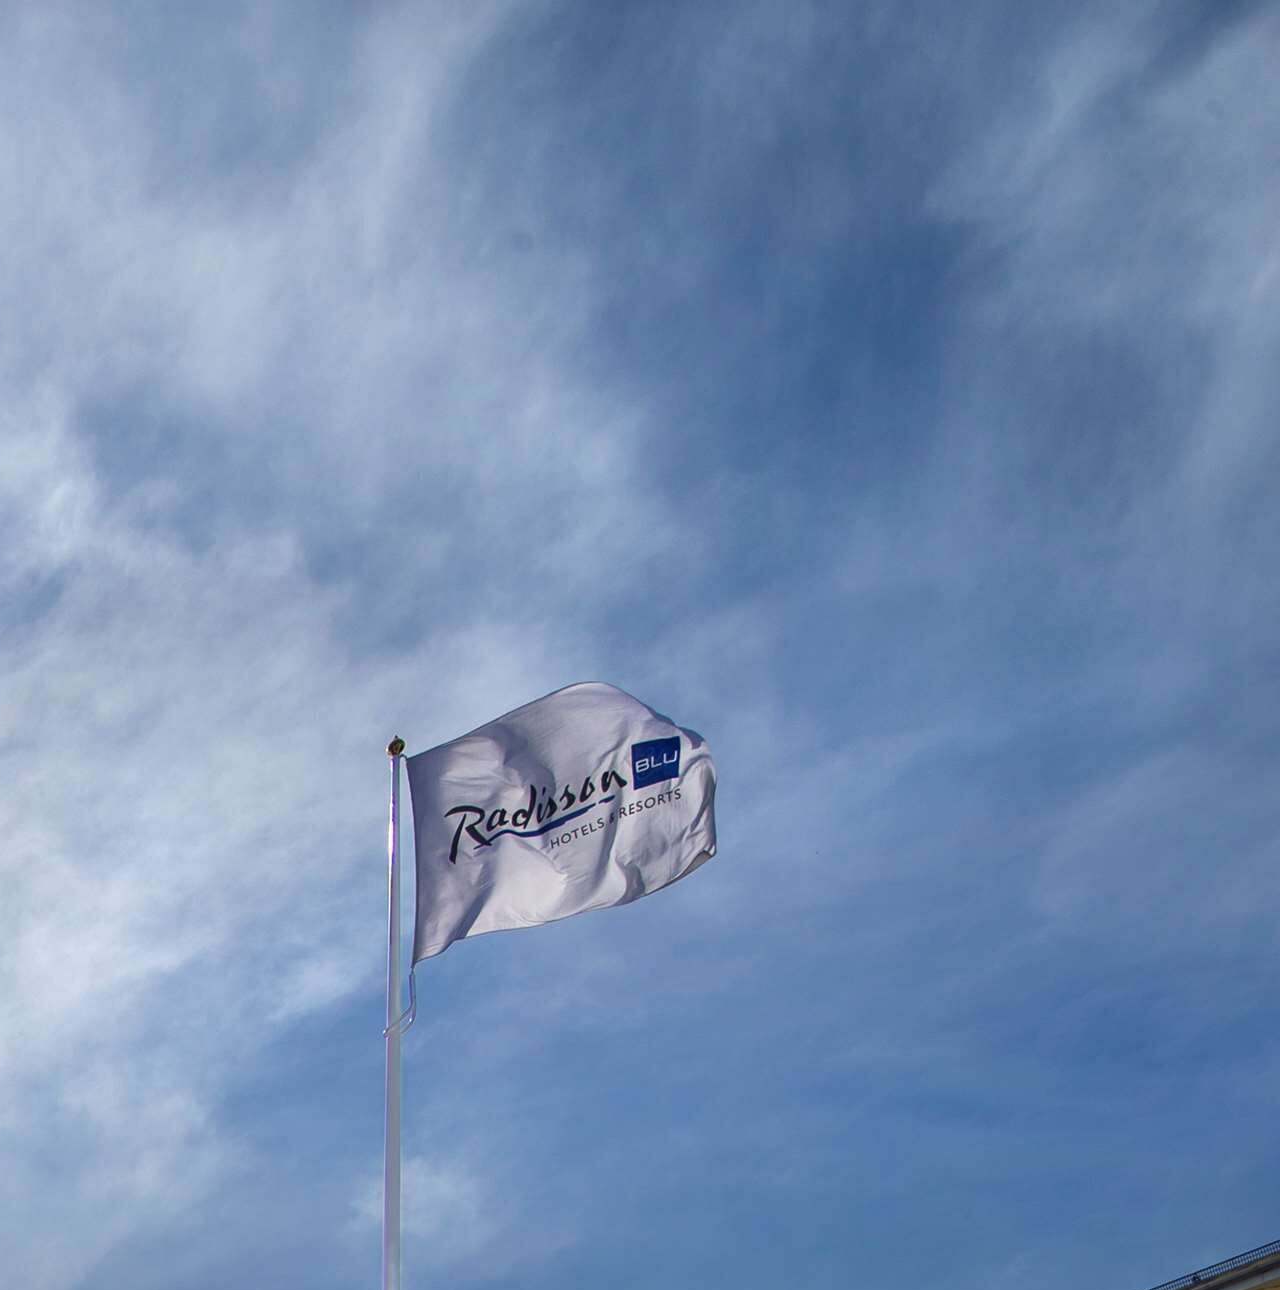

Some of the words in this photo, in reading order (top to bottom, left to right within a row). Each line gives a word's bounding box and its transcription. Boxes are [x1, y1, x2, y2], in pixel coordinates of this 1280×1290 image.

[444, 769, 627, 864] Radisson
[635, 750, 678, 773] BLU
[550, 818, 605, 848] HOTELS
[618, 788, 682, 819] RESORTS
